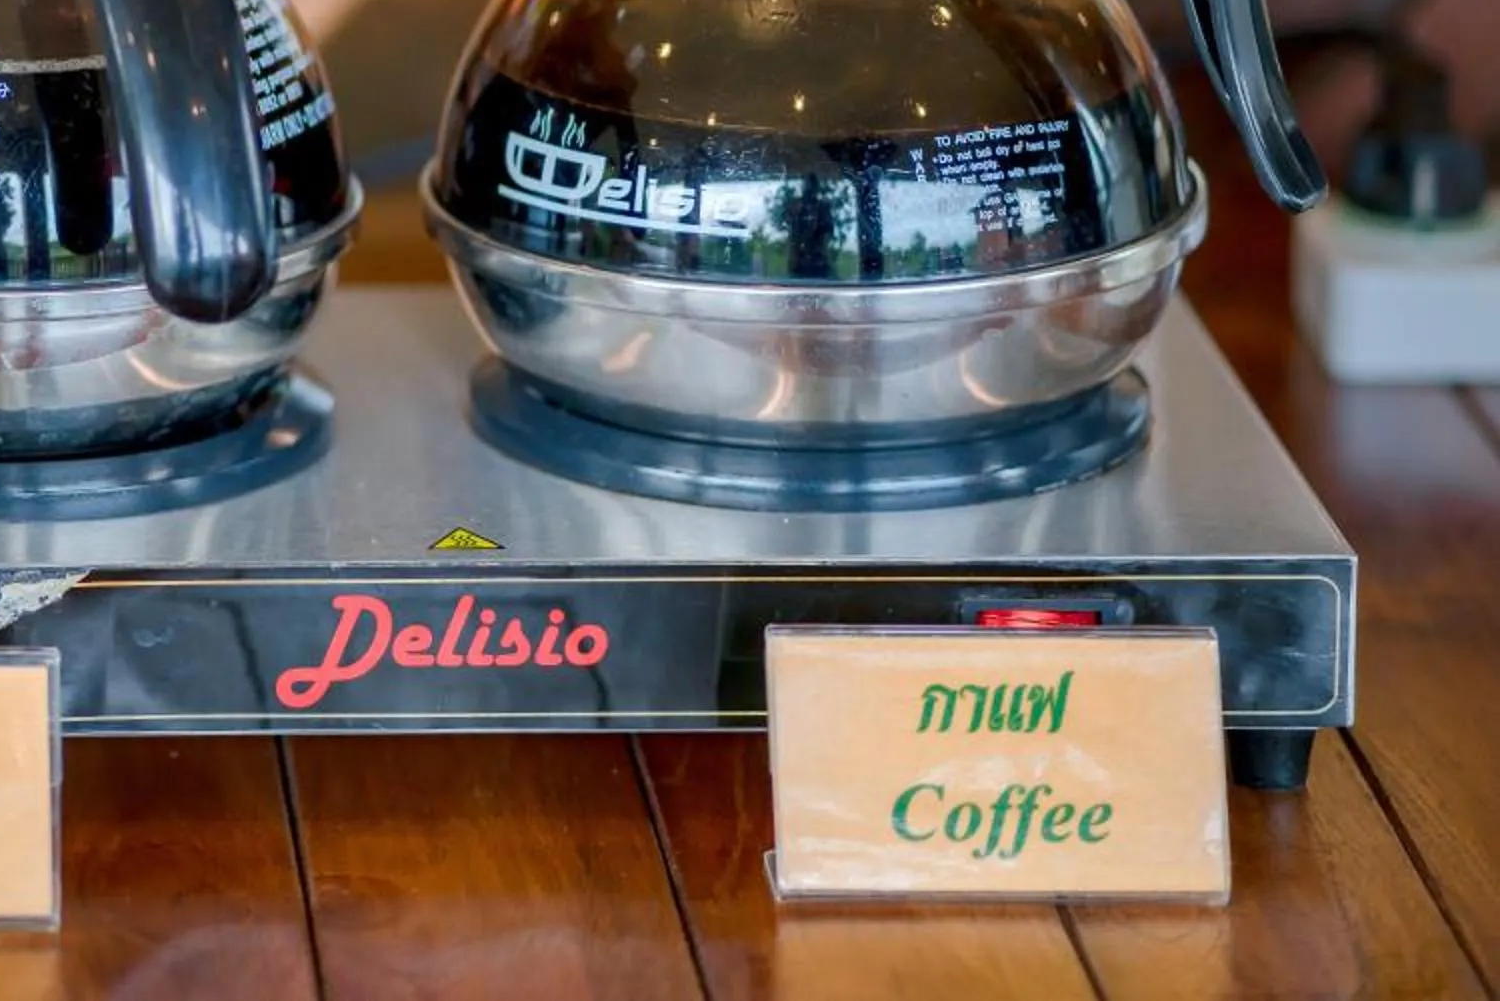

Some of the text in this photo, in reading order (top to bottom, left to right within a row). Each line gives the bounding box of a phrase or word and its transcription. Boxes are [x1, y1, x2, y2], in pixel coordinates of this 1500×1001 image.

[934, 135, 951, 148] TO
[1015, 123, 1035, 136] AND
[505, 131, 749, 222] Deliso
[275, 594, 610, 709] Delisio
[916, 670, 1074, 734] กาแฟ
[891, 783, 1113, 859] Coffee
